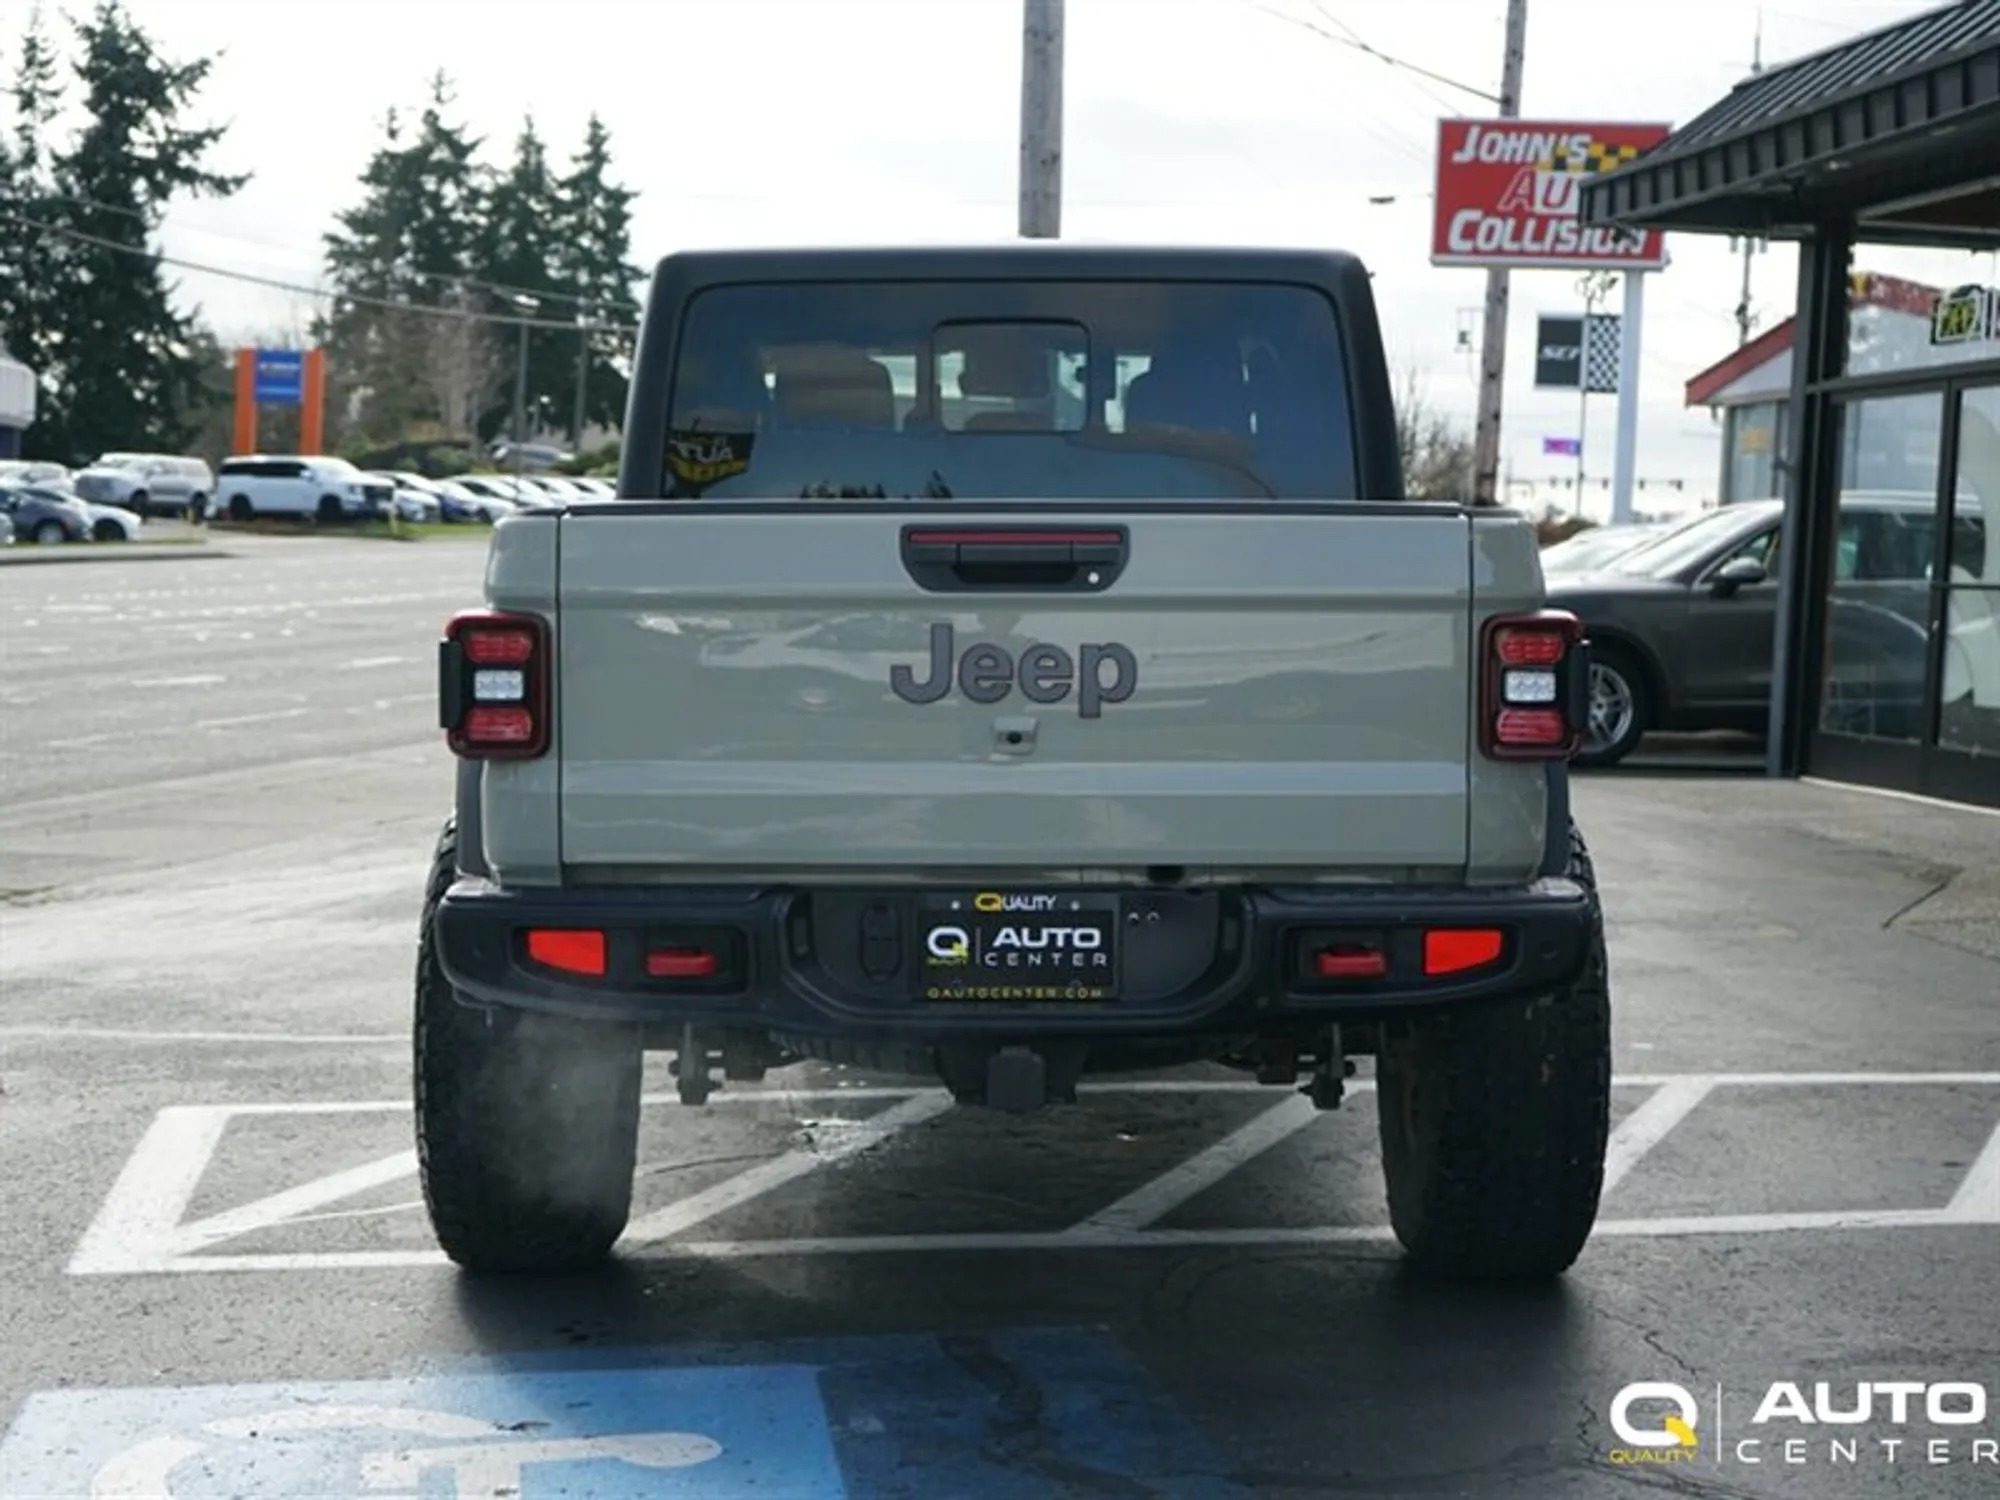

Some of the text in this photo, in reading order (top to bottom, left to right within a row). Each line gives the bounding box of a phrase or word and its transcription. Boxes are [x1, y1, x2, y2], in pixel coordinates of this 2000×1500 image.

[1452, 125, 1592, 164] JOHN'S
[890, 622, 1138, 719] Jeep
[975, 892, 1057, 911] QUALITY
[993, 926, 1101, 949] AUTO
[984, 952, 1107, 967] CENTER
